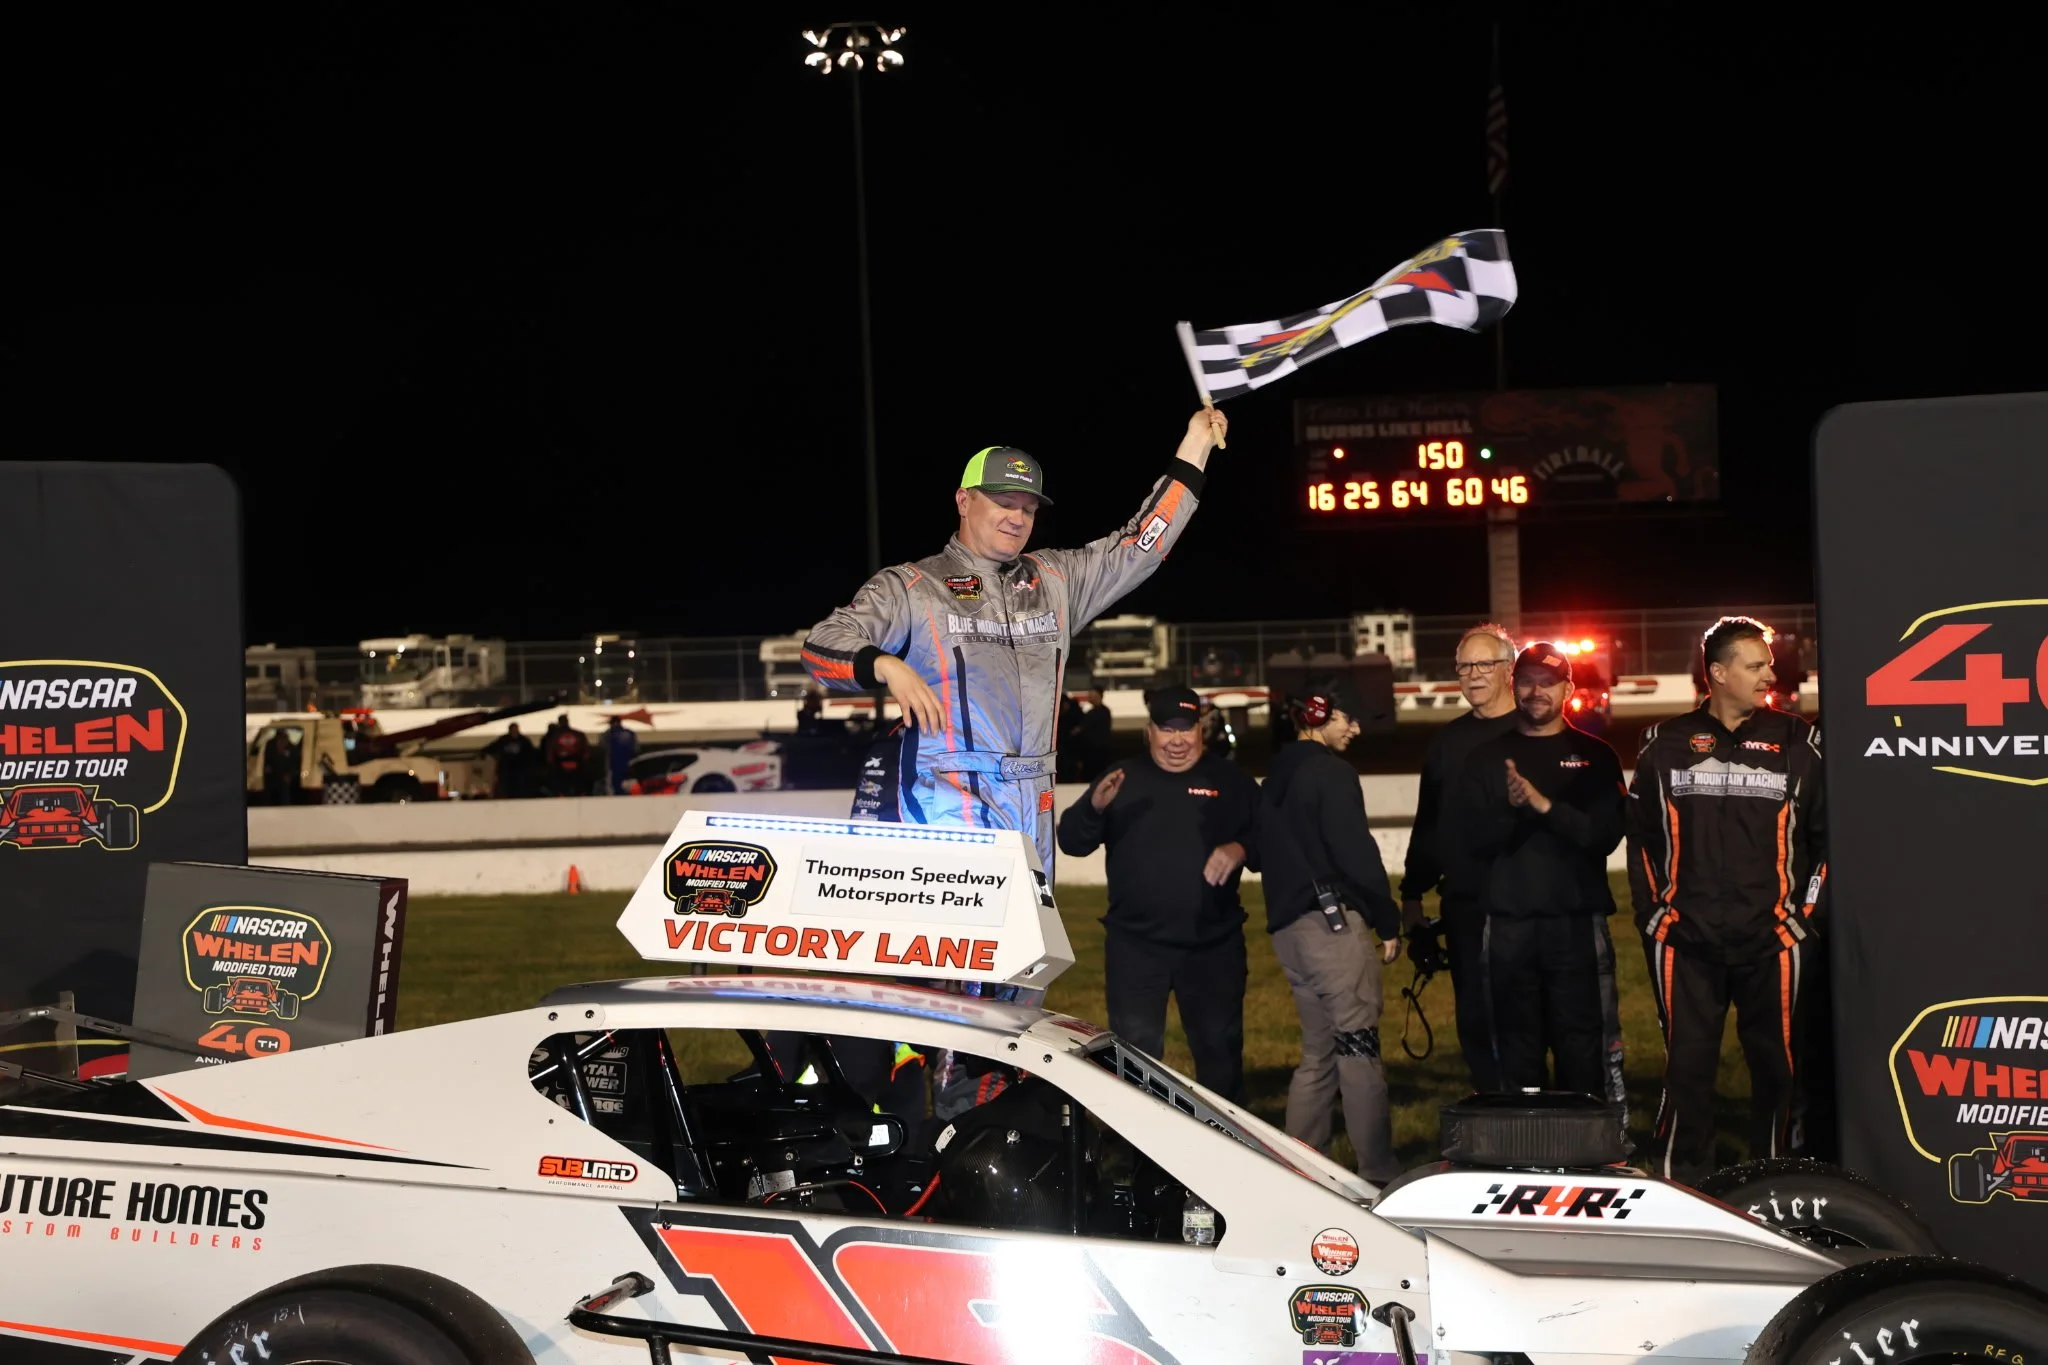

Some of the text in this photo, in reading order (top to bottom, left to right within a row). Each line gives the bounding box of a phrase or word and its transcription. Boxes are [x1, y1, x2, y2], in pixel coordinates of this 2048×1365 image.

[1418, 441, 1464, 470] 150
[1308, 476, 1528, 511] 16 25 64 60 46
[947, 611, 1058, 637] BLUE MOUNTAIN MACHINE
[1866, 623, 2048, 726] 4
[0, 678, 137, 710] NASCAR
[1864, 735, 2048, 757] ANNIVE
[0, 758, 128, 780] DIFIED TOUR
[1671, 769, 1787, 791] BLUE MOUNTAIN MACHINE
[703, 849, 758, 864] NASCAR
[675, 859, 765, 881] WHELEN
[805, 859, 1007, 889] Thompson Speedway
[685, 878, 748, 889] MODIFIED TOUR
[817, 882, 985, 908] Motorsports Park
[233, 915, 308, 939] NASCAR
[193, 931, 320, 966] WHELEN
[663, 918, 998, 971] VICTORY LANE
[212, 960, 298, 978] MODIFIED TOUR
[198, 1025, 291, 1058] 40 TH
[195, 1056, 233, 1065] ANNI
[583, 1063, 618, 1077] TAL
[585, 1076, 620, 1090] WER
[548, 1180, 592, 1188] PERFORMANCE
[126, 1181, 268, 1230] HOMES
[1746, 1190, 1828, 1223] sier
[110, 1227, 263, 1251] BUILDERS
[1295, 1300, 1362, 1316] WHELEN
[1316, 1291, 1354, 1303] NASCAR
[1307, 1315, 1335, 1323] MODIFIED
[1829, 1318, 1920, 1365] ier
